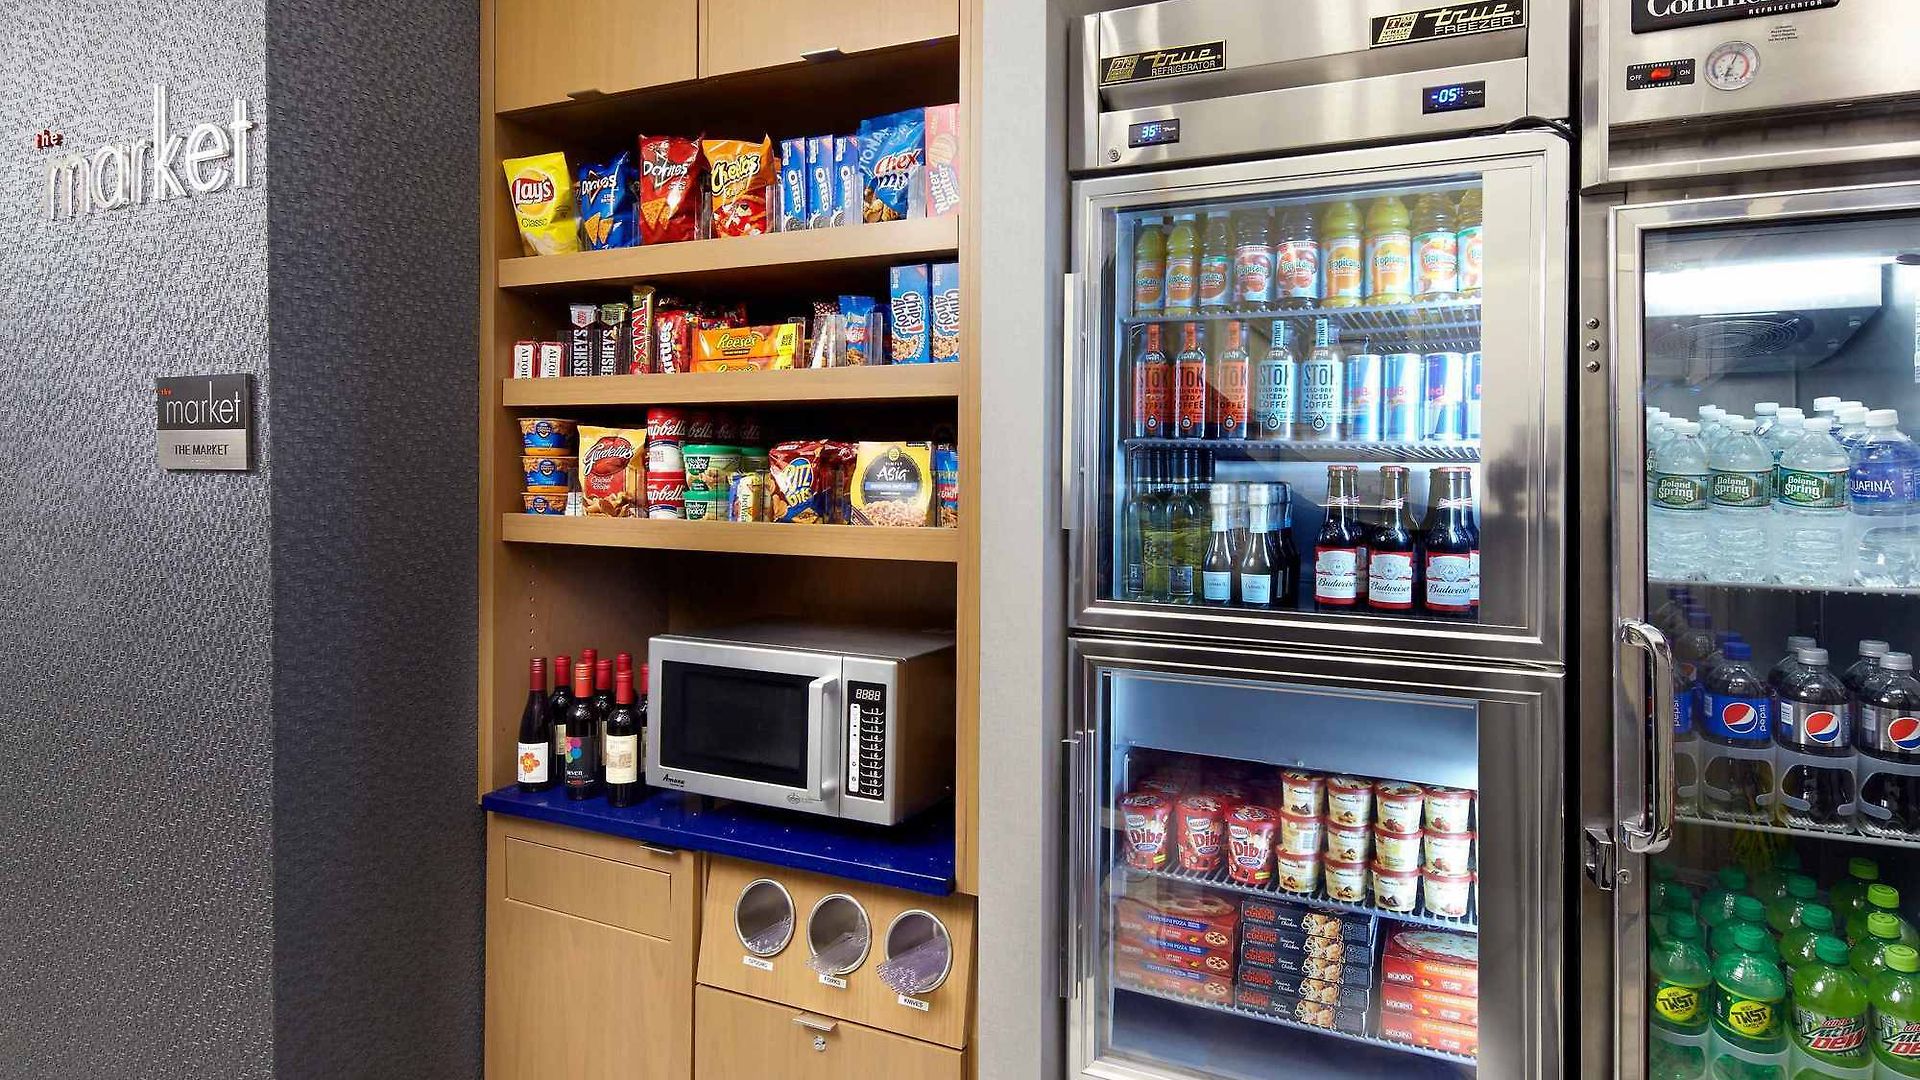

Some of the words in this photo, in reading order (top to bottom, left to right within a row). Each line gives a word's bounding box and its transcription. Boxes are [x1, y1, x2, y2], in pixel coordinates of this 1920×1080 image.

[1423, 3, 1516, 27] true
[1434, 16, 1515, 36] FREEZER
[1151, 59, 1216, 77] REFRIGERATOR
[1629, 74, 1642, 82] OFF
[46, 84, 254, 220] market
[643, 161, 688, 178] Doritos
[874, 148, 922, 176] Chex
[515, 178, 553, 204] Lay's
[788, 170, 801, 214] OREO
[815, 167, 829, 211] OREO
[903, 292, 922, 326] Chips
[631, 300, 648, 362] TWIX
[716, 333, 758, 350] Reese's
[600, 329, 617, 377] ERSHEY'S
[166, 381, 241, 424] market
[175, 444, 191, 456] THE
[193, 444, 230, 456] MARKET
[876, 465, 910, 482] Asia
[1716, 475, 1747, 487] Poland
[1788, 474, 1818, 486] Poland
[1661, 478, 1692, 490] Poland
[1713, 484, 1750, 499] Spring
[1784, 483, 1821, 498] Spring
[1657, 487, 1694, 502] Spring
[1131, 829, 1164, 844] Dibs
[1193, 831, 1221, 848] Dib
[1731, 1007, 1768, 1024] TWST
[1809, 1026, 1867, 1052] DEW
